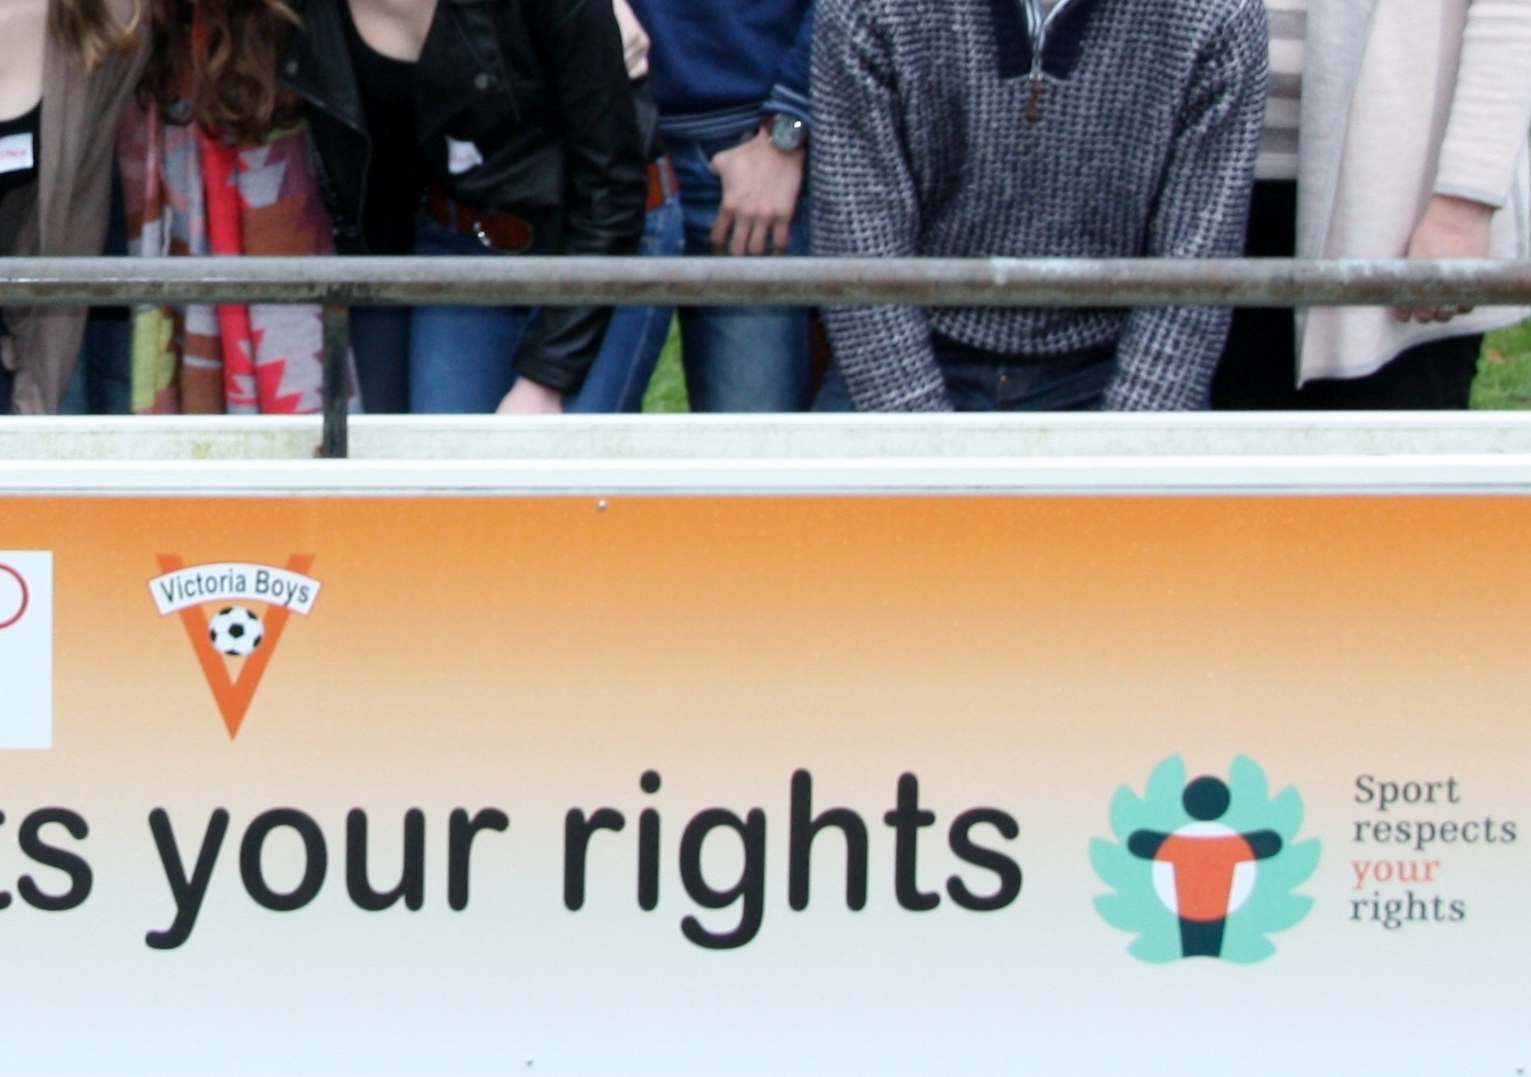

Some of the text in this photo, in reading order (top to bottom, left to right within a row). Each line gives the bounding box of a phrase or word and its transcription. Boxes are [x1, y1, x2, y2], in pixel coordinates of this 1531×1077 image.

[160, 568, 310, 607] Victoria Boys
[1354, 775, 1460, 811] Sport
[1353, 817, 1518, 850] respects
[145, 807, 509, 950] your
[563, 769, 1022, 950] rights
[1351, 858, 1441, 890] your
[1350, 890, 1466, 930] rights
